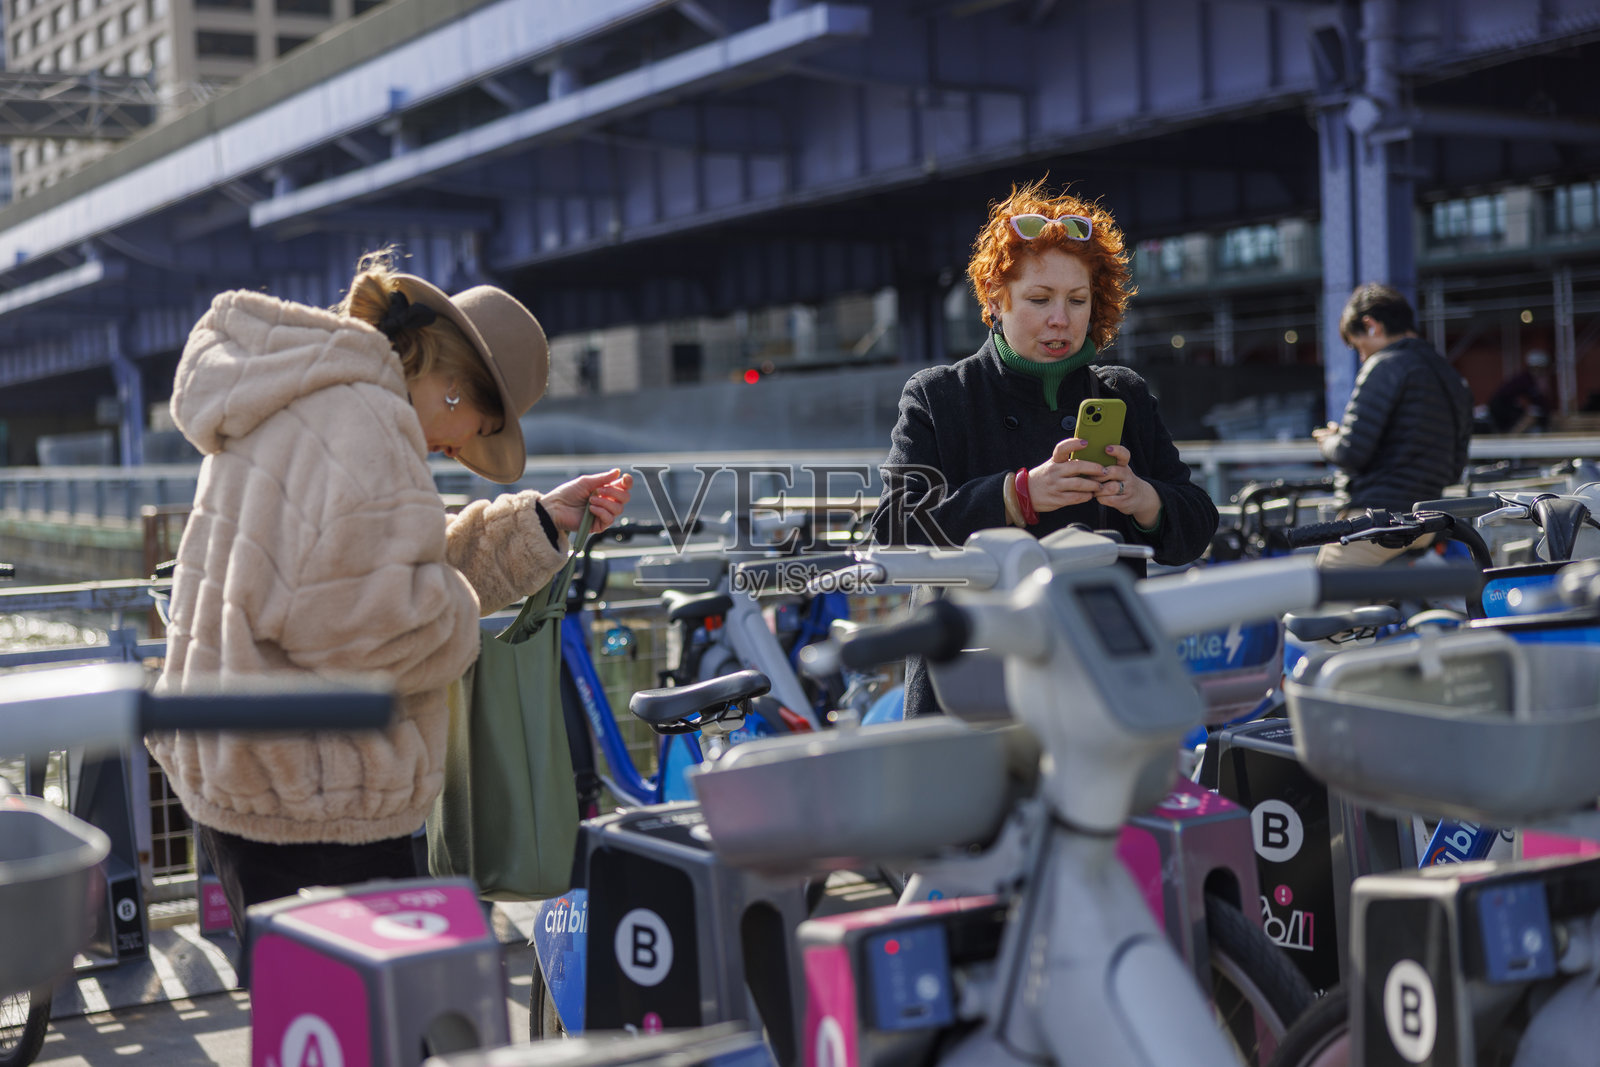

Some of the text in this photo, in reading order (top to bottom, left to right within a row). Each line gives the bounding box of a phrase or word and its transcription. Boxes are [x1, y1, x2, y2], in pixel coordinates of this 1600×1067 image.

[1262, 811, 1290, 850] B
[1444, 818, 1481, 855] bi
[545, 900, 588, 933] citi bi
[631, 923, 658, 970] B
[1401, 984, 1422, 1038] B
